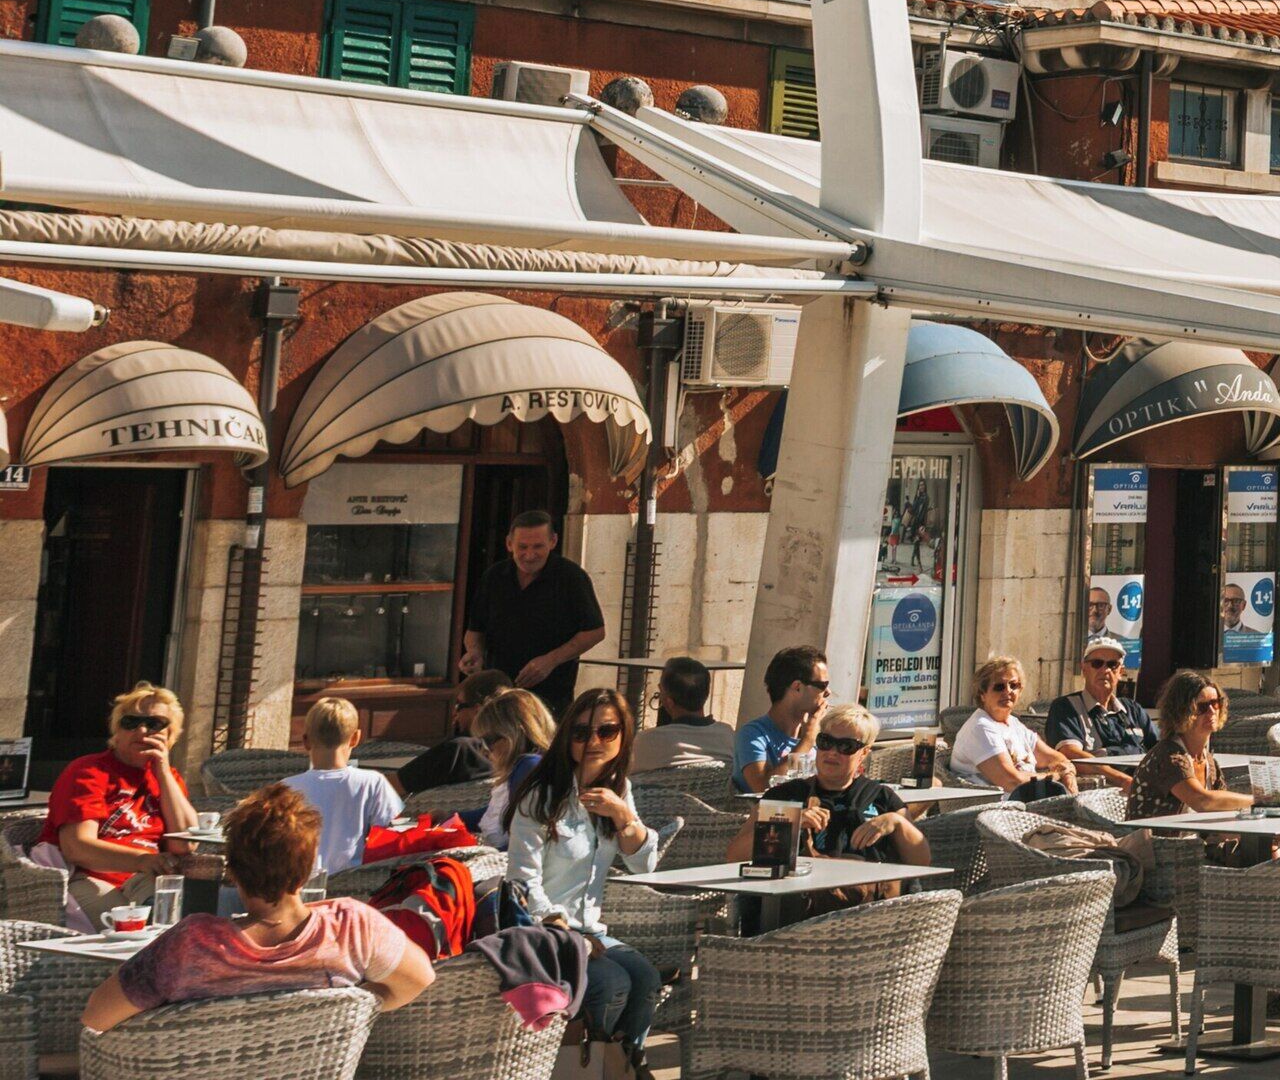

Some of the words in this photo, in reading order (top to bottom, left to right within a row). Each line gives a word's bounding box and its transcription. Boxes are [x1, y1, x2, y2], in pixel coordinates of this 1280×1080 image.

[501, 395, 521, 413] A.
[1108, 395, 1198, 435] OPTIKA
[102, 416, 267, 448] TEHNIČAR
[4, 468, 24, 482] 14
[1121, 594, 1142, 609] 1+1
[876, 657, 923, 673] PREGLEDI
[875, 674, 911, 685] svakim
[875, 695, 899, 709] ULAZ
